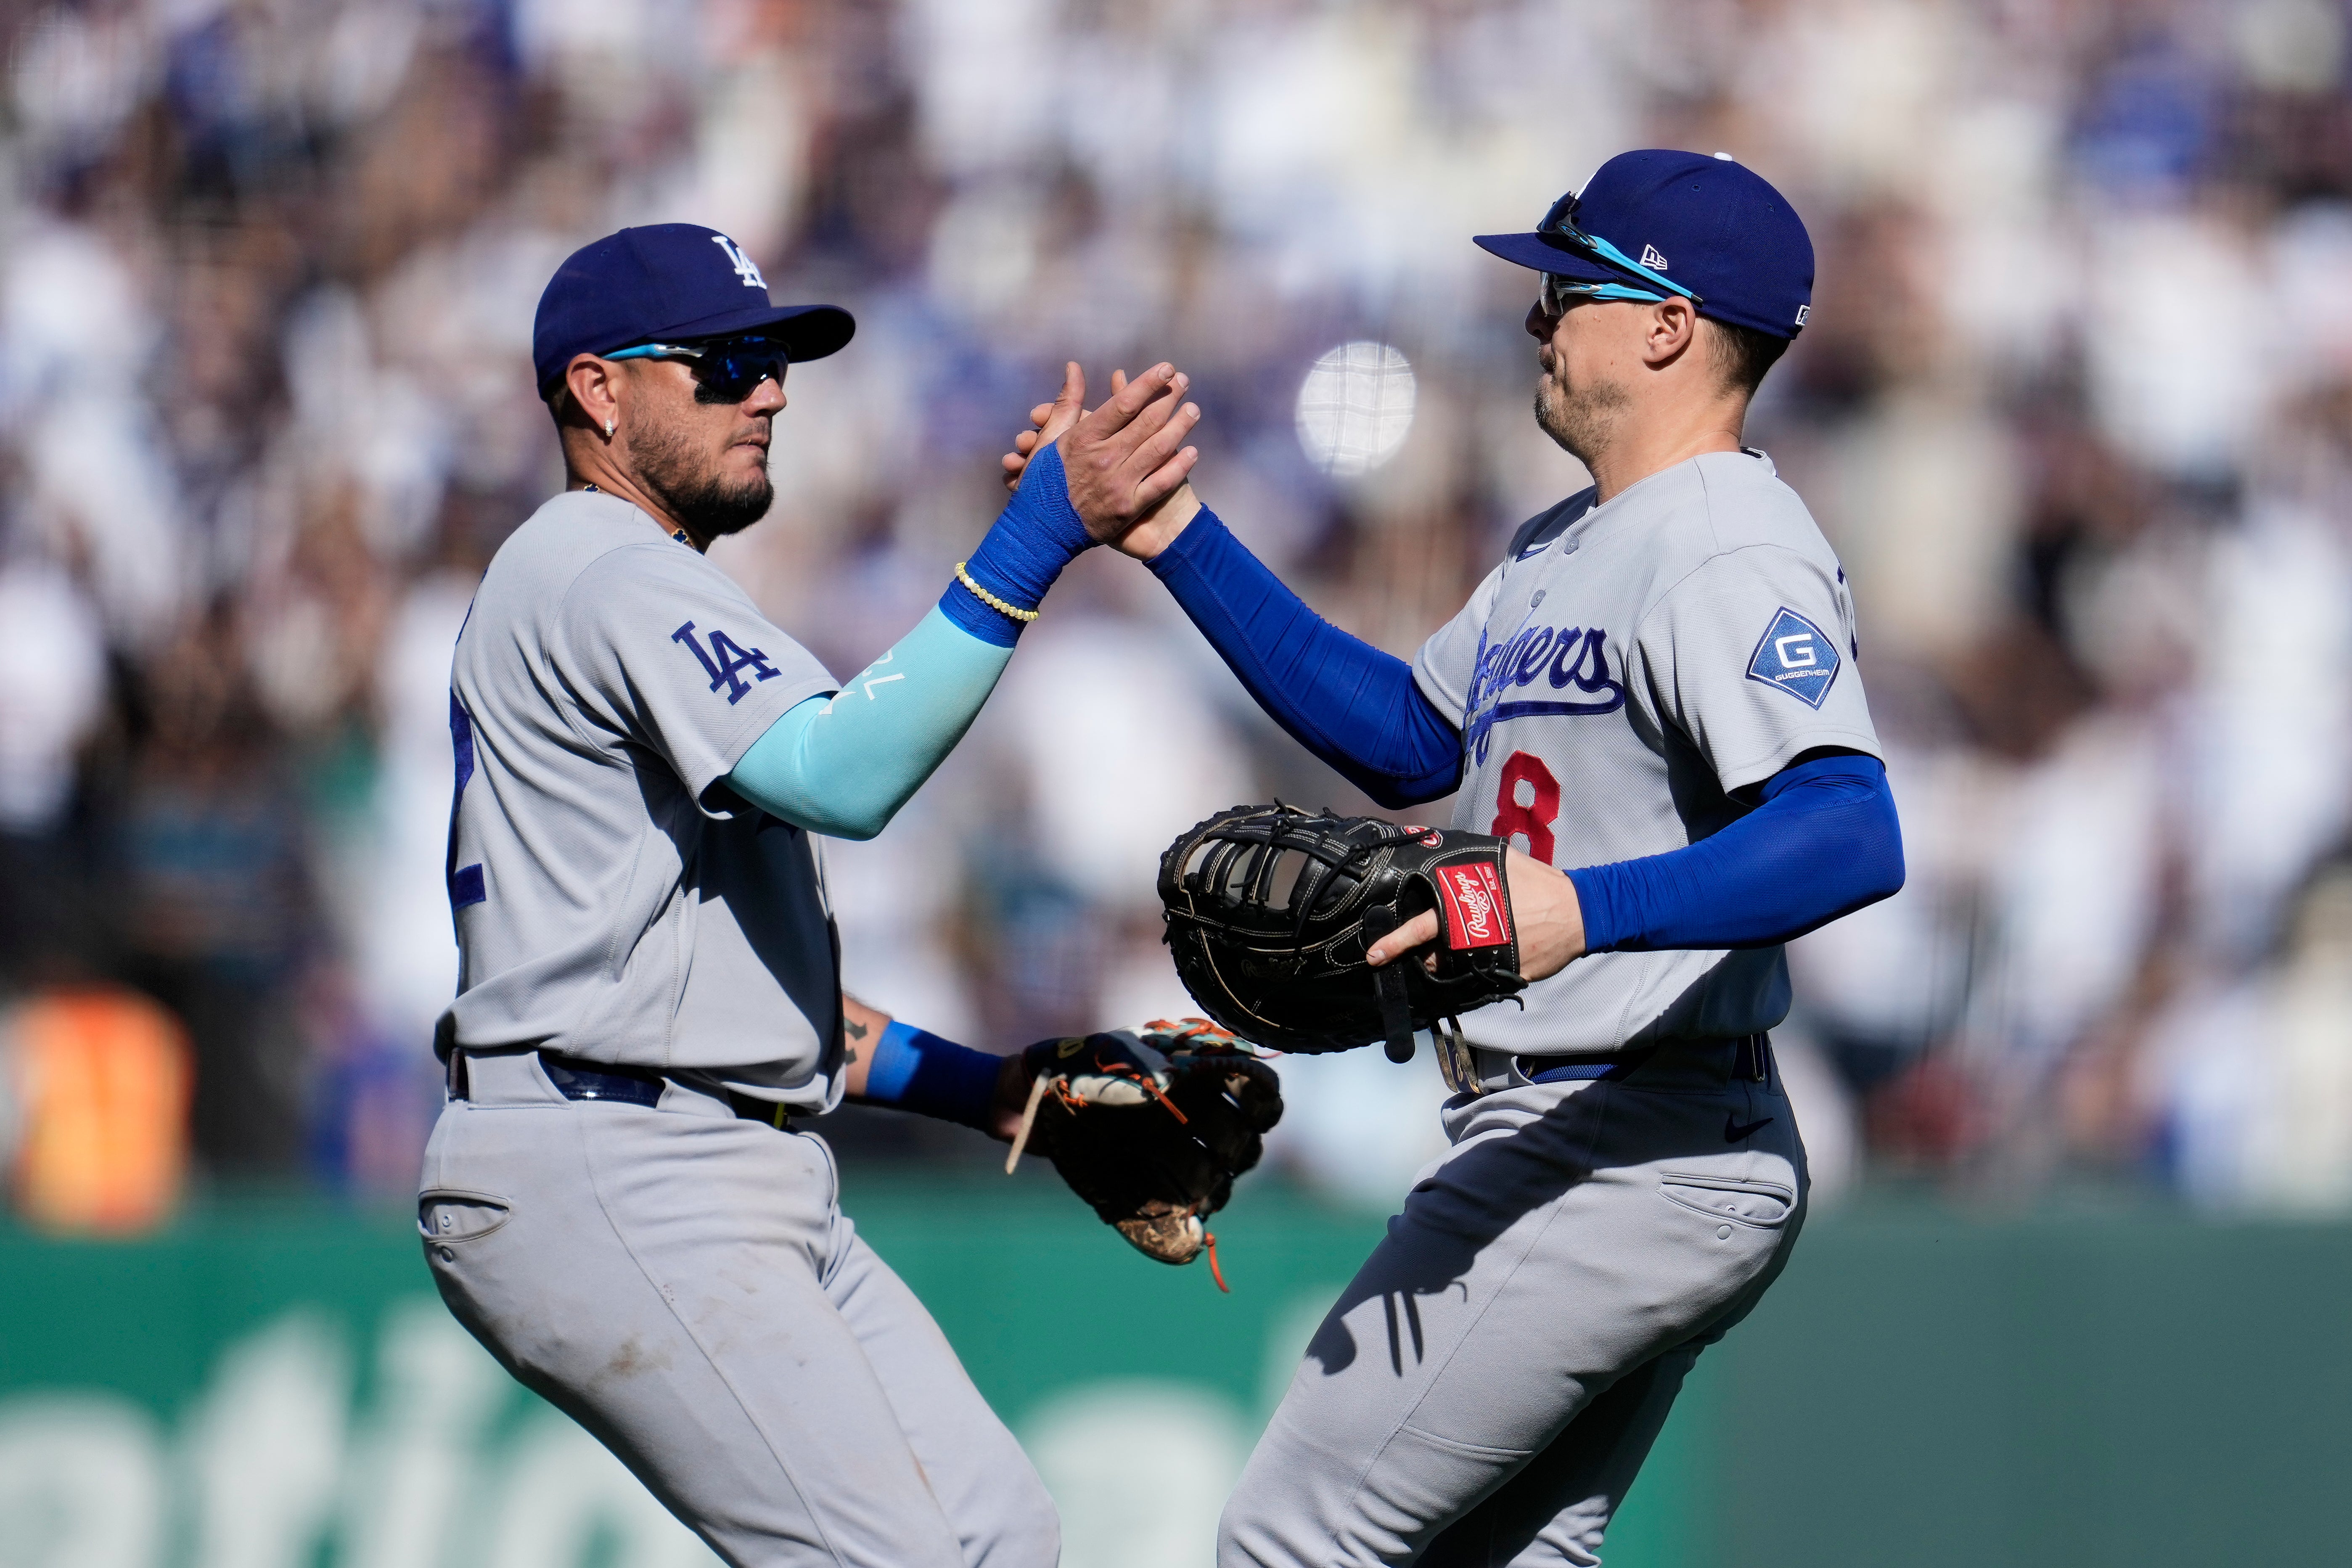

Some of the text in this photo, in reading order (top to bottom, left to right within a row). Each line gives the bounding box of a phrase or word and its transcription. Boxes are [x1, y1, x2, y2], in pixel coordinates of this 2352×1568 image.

[711, 235, 767, 289] LA
[671, 620, 782, 706] LA
[1775, 633, 1817, 668] G
[1775, 669, 1830, 682] GUGGENHEIM
[1492, 749, 1561, 867] 8
[1454, 871, 1490, 938] Rawlings
